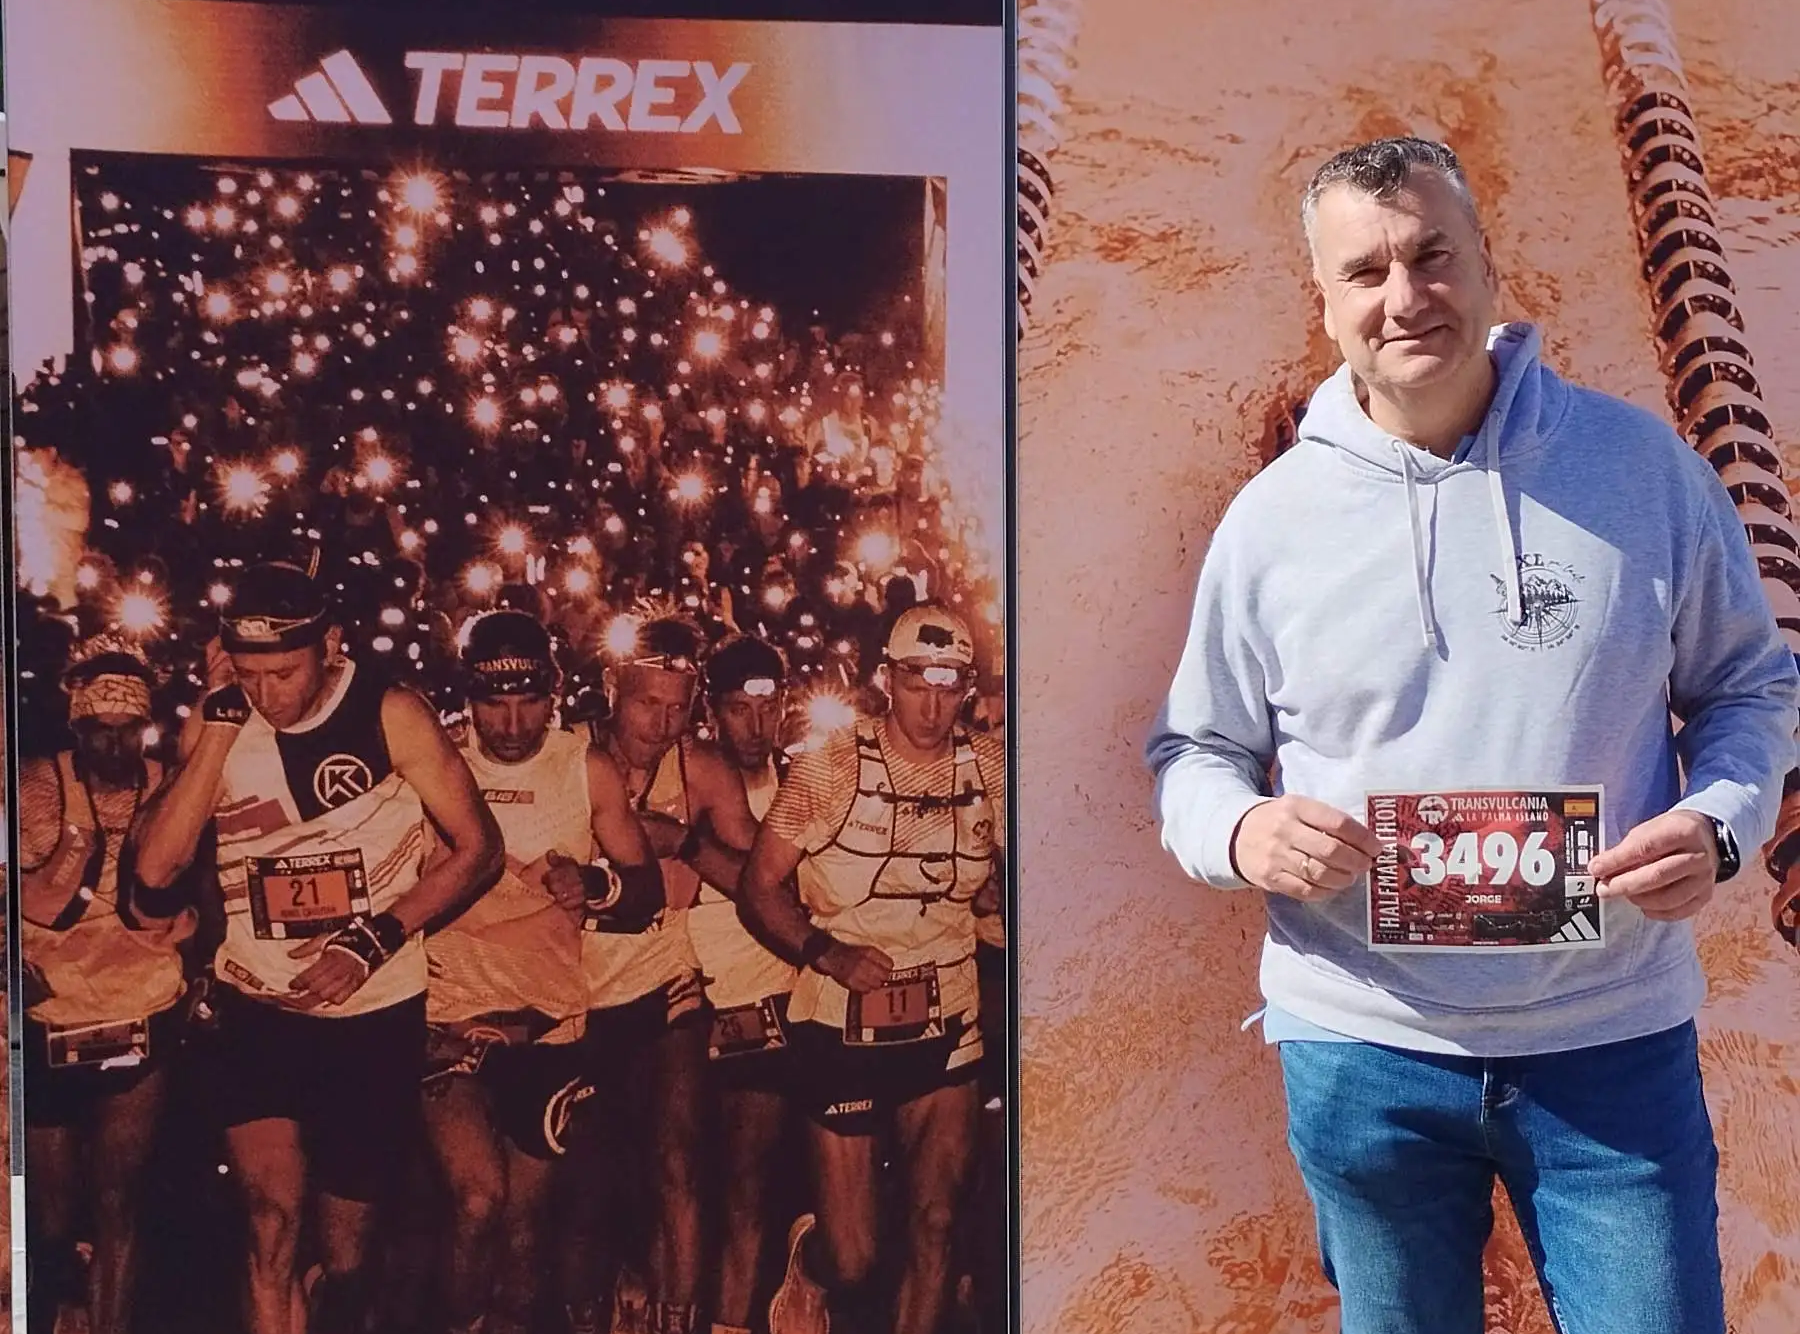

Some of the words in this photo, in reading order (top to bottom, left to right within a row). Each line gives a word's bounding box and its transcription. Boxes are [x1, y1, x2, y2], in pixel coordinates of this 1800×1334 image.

[403, 50, 752, 135] TERREX
[1450, 796, 1549, 811] TRANSVULCANIA
[1482, 812, 1511, 822] PALMA
[1516, 811, 1549, 821] ISLAND
[1374, 797, 1400, 928] HALFMARATHON
[1410, 831, 1556, 887] 3496
[289, 877, 320, 907] 21
[1465, 894, 1503, 904] JORGE
[1576, 881, 1585, 892] 2
[885, 988, 907, 1014] 11
